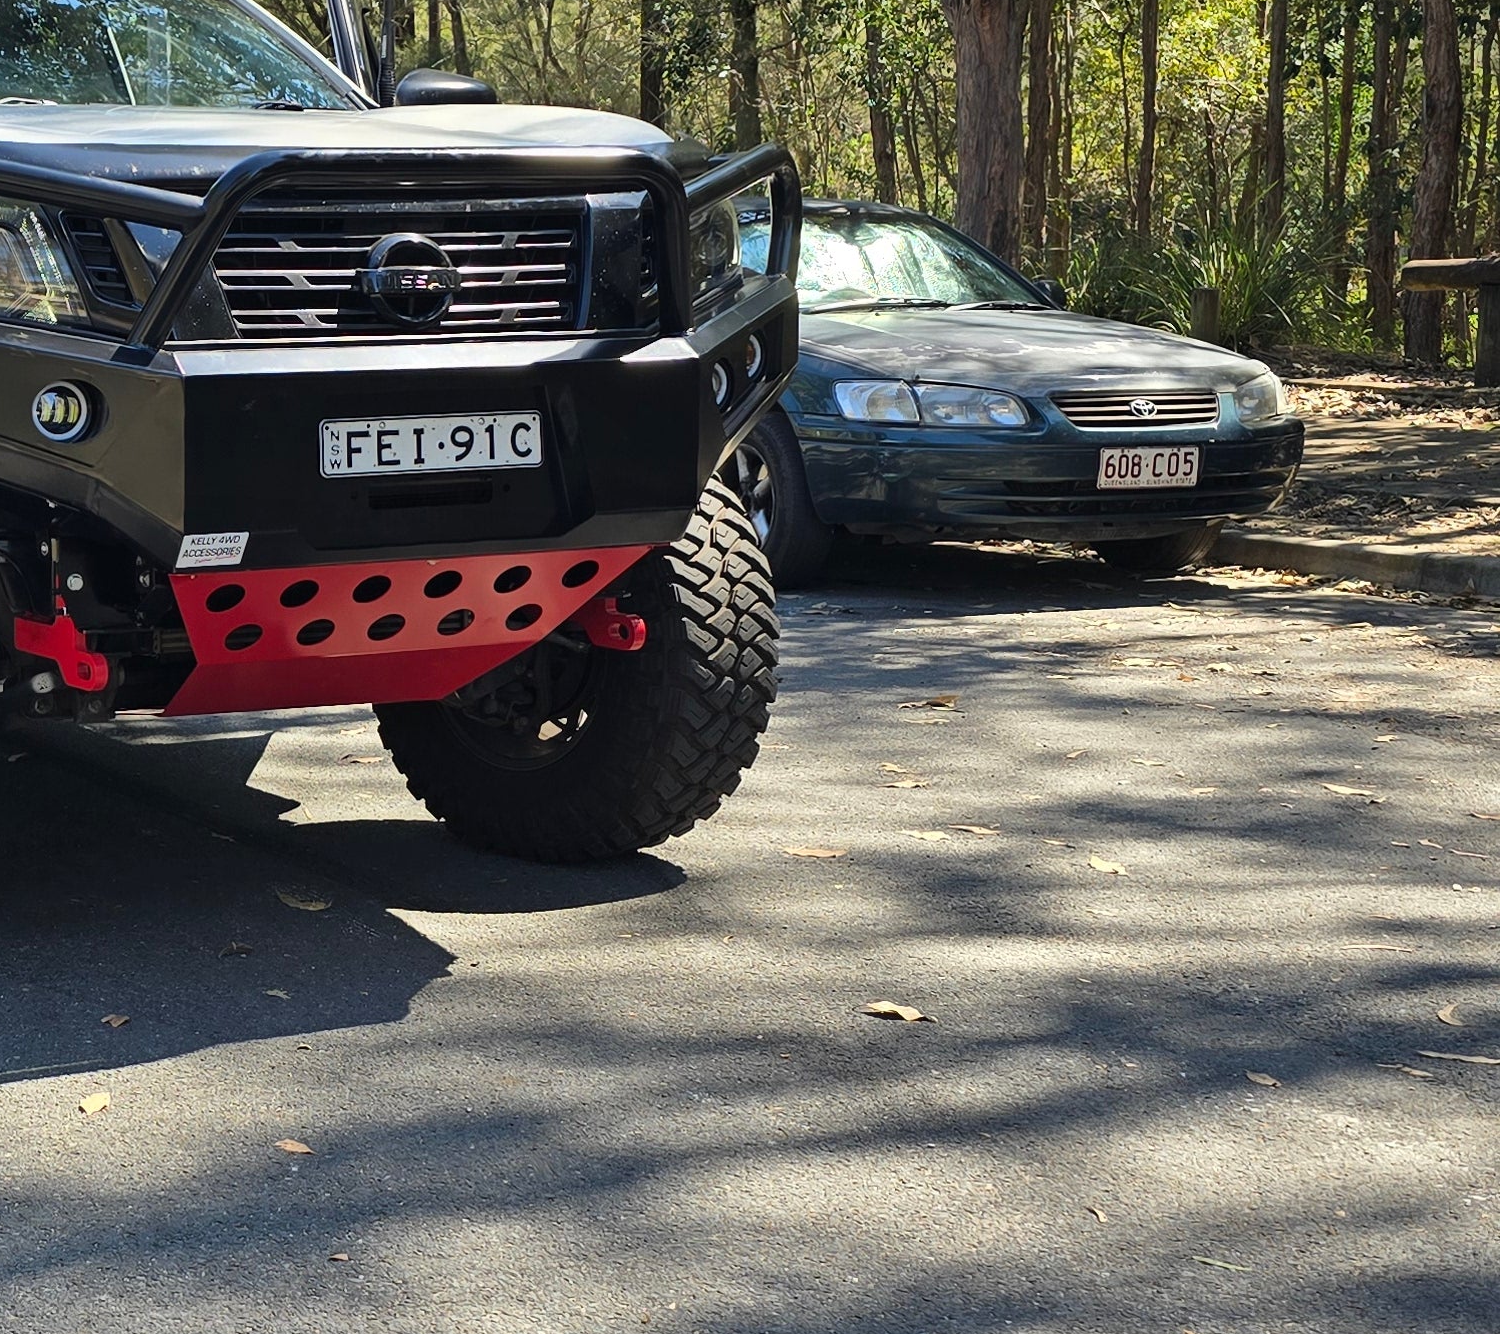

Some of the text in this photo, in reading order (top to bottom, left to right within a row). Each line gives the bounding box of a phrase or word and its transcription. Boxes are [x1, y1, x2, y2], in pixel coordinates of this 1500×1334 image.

[190, 535, 241, 545] KELLY 4WD
[182, 546, 242, 558] ACCESSORIES
